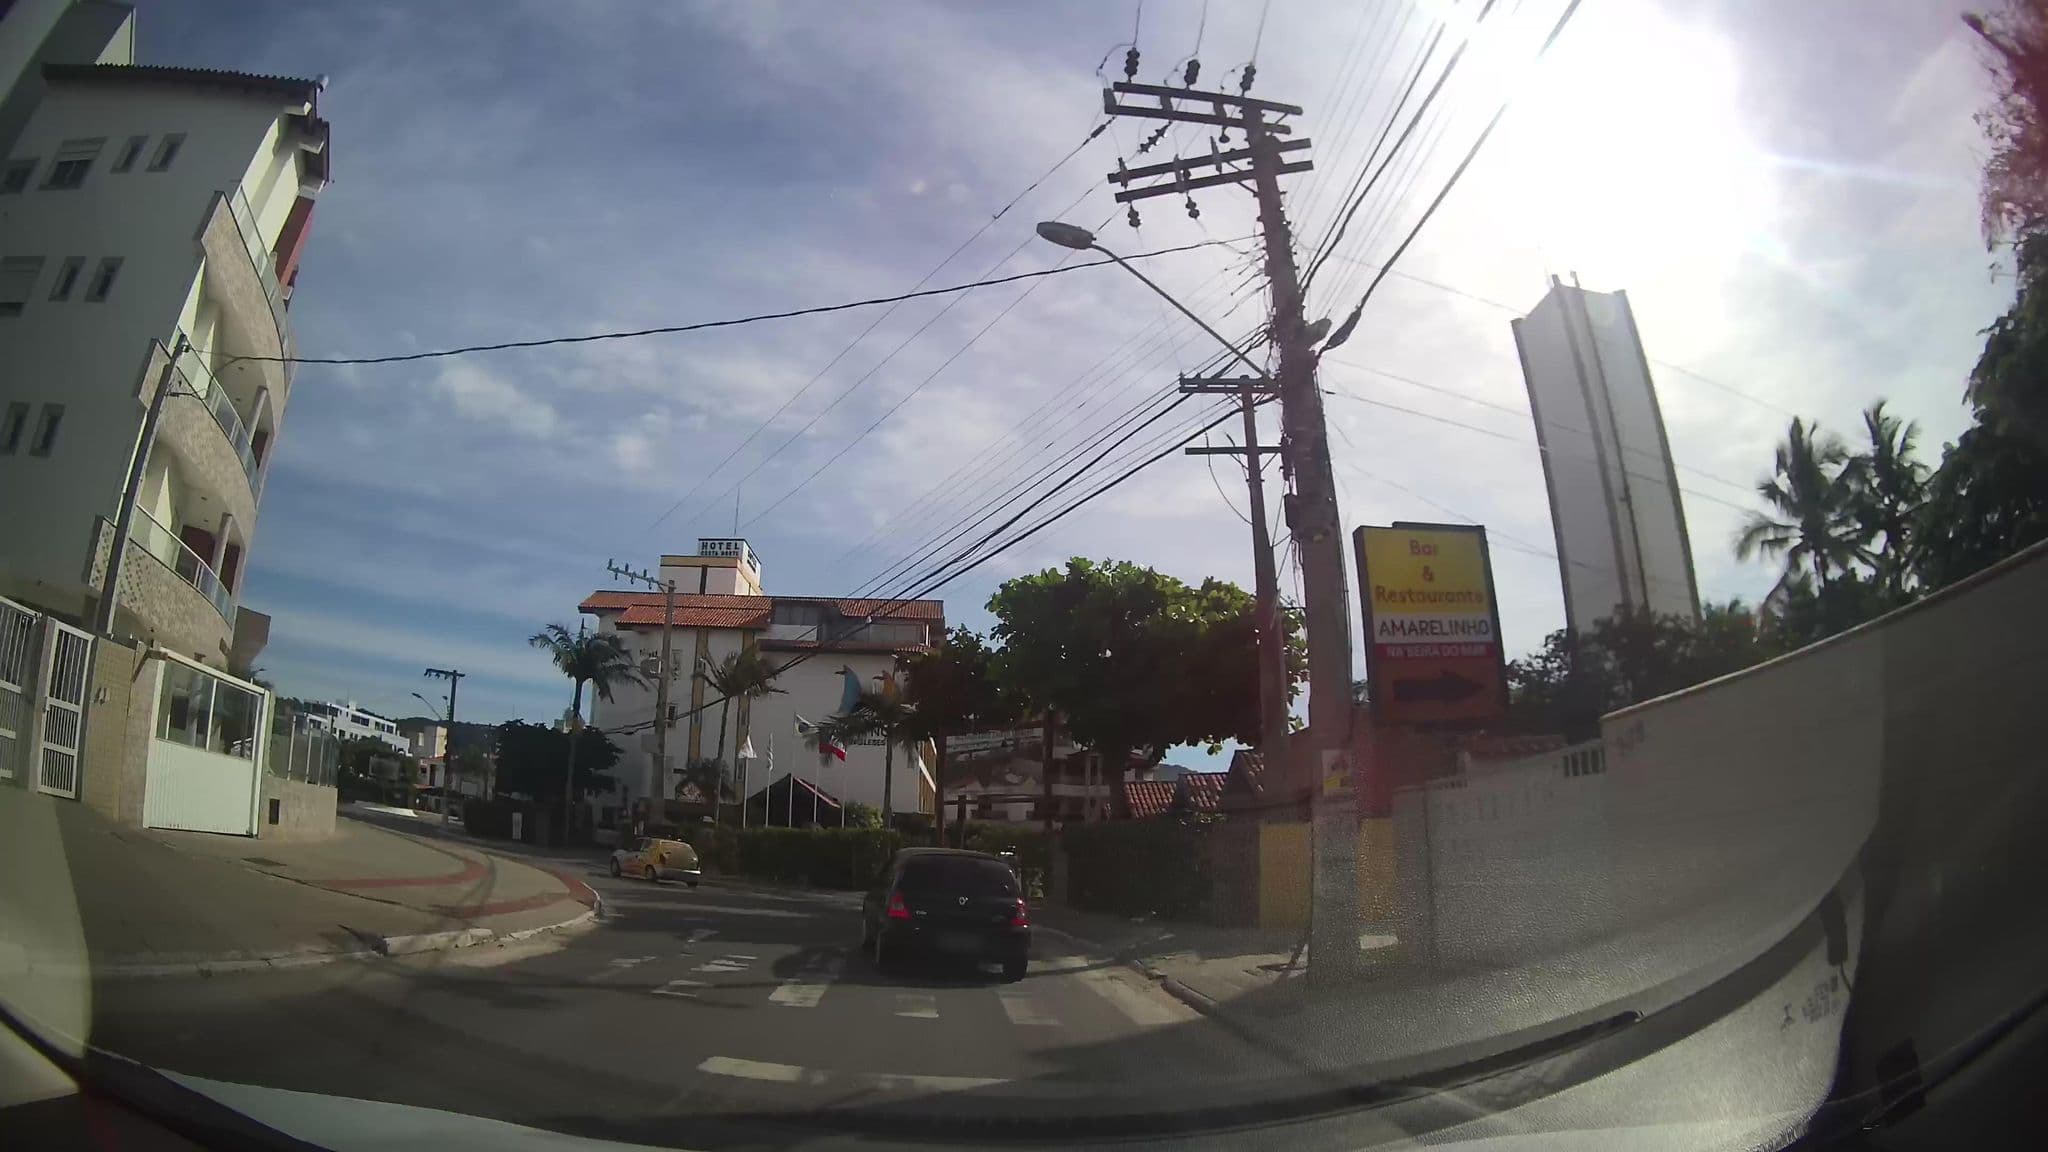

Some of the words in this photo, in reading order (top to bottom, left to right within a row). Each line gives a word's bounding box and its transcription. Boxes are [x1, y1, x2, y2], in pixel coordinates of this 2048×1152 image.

[701, 542, 740, 550] HOTEL
[1409, 539, 1438, 556] Bar
[1422, 566, 1434, 582] &
[1375, 585, 1483, 604] Restaurante
[1380, 619, 1489, 636] AMARELINHO
[1441, 645, 1459, 656] DO
